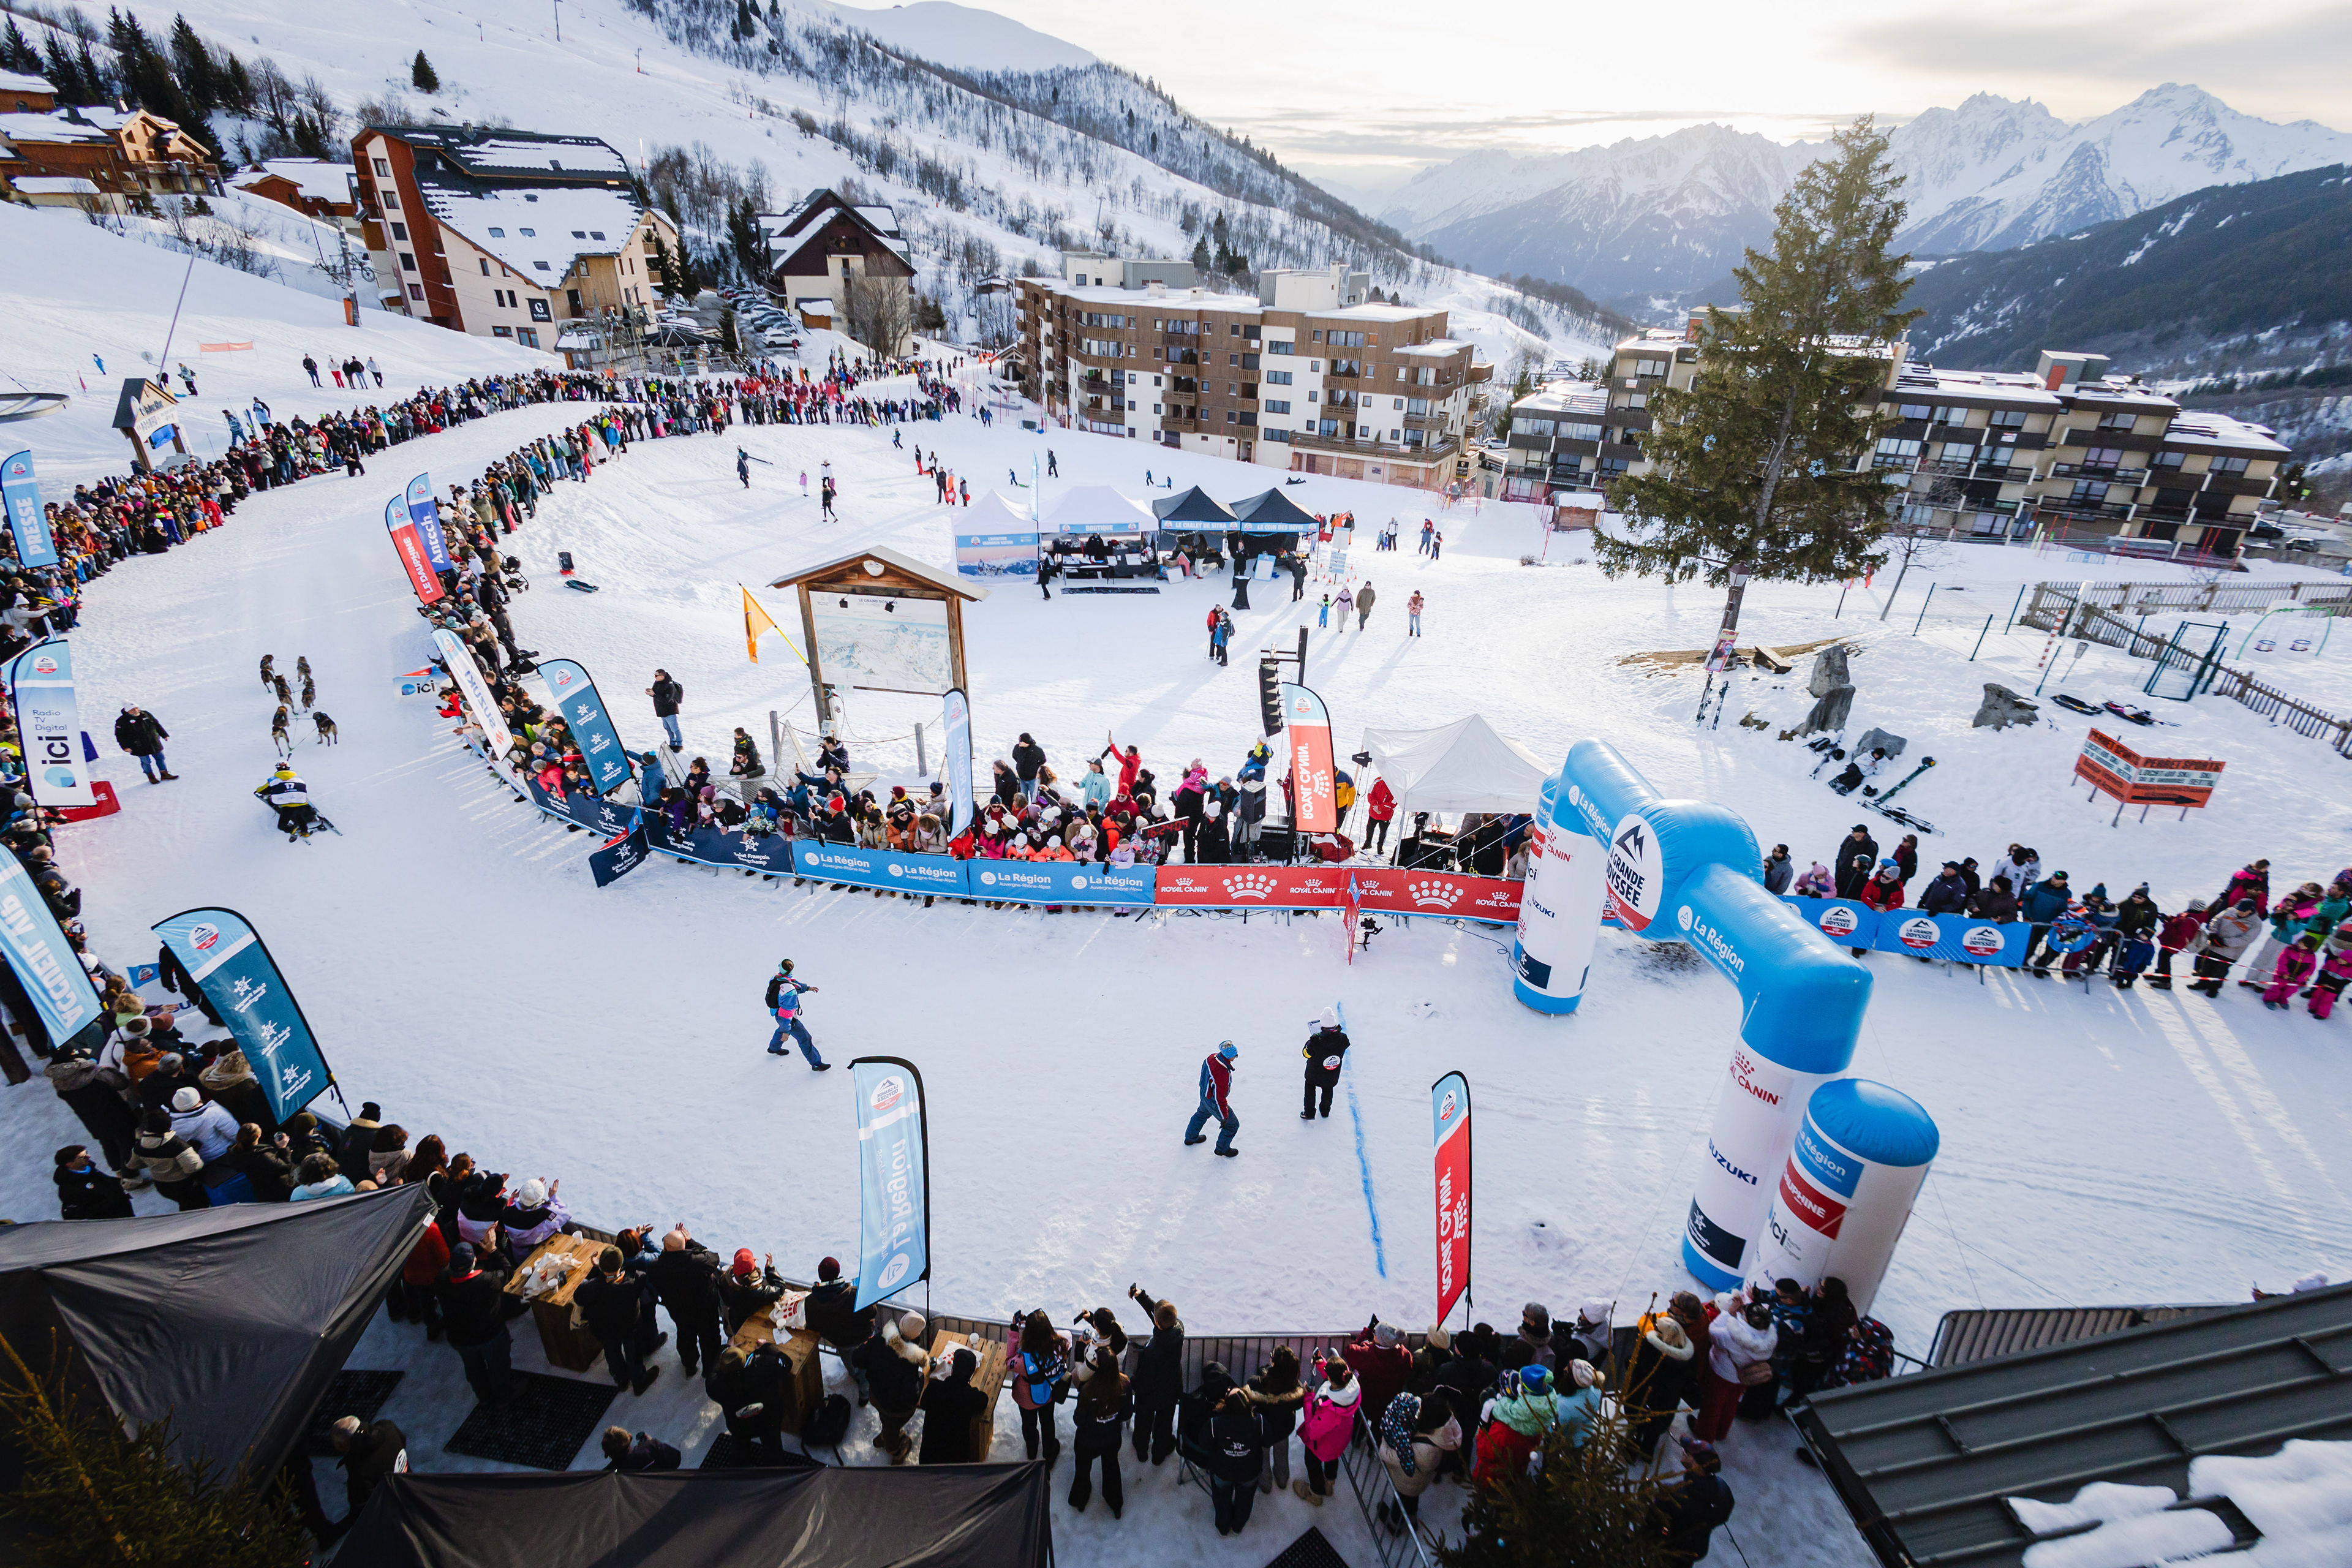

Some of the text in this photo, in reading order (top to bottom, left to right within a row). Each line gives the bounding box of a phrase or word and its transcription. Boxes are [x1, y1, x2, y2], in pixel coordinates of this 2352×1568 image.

[15, 497, 46, 556] PRESSE
[417, 679, 435, 694] ici
[35, 724, 67, 733] Digital
[37, 736, 72, 764] ici
[1579, 793, 1611, 839] La Région
[820, 853, 870, 868] La Région
[1547, 843, 1571, 862] CANIN
[904, 865, 957, 879] La Région
[998, 872, 1051, 884] La Région
[999, 881, 1051, 890] Auvergne-Rhône-Alpes
[1089, 875, 1143, 887] La Région
[1606, 858, 1642, 908] ODYSSÉE
[1613, 853, 1645, 890] GRANDE
[1693, 915, 1744, 973] La Région
[1738, 1075, 1779, 1106] CANIN
[1804, 1136, 1846, 1177] Région
[1770, 1212, 1788, 1246] ici
